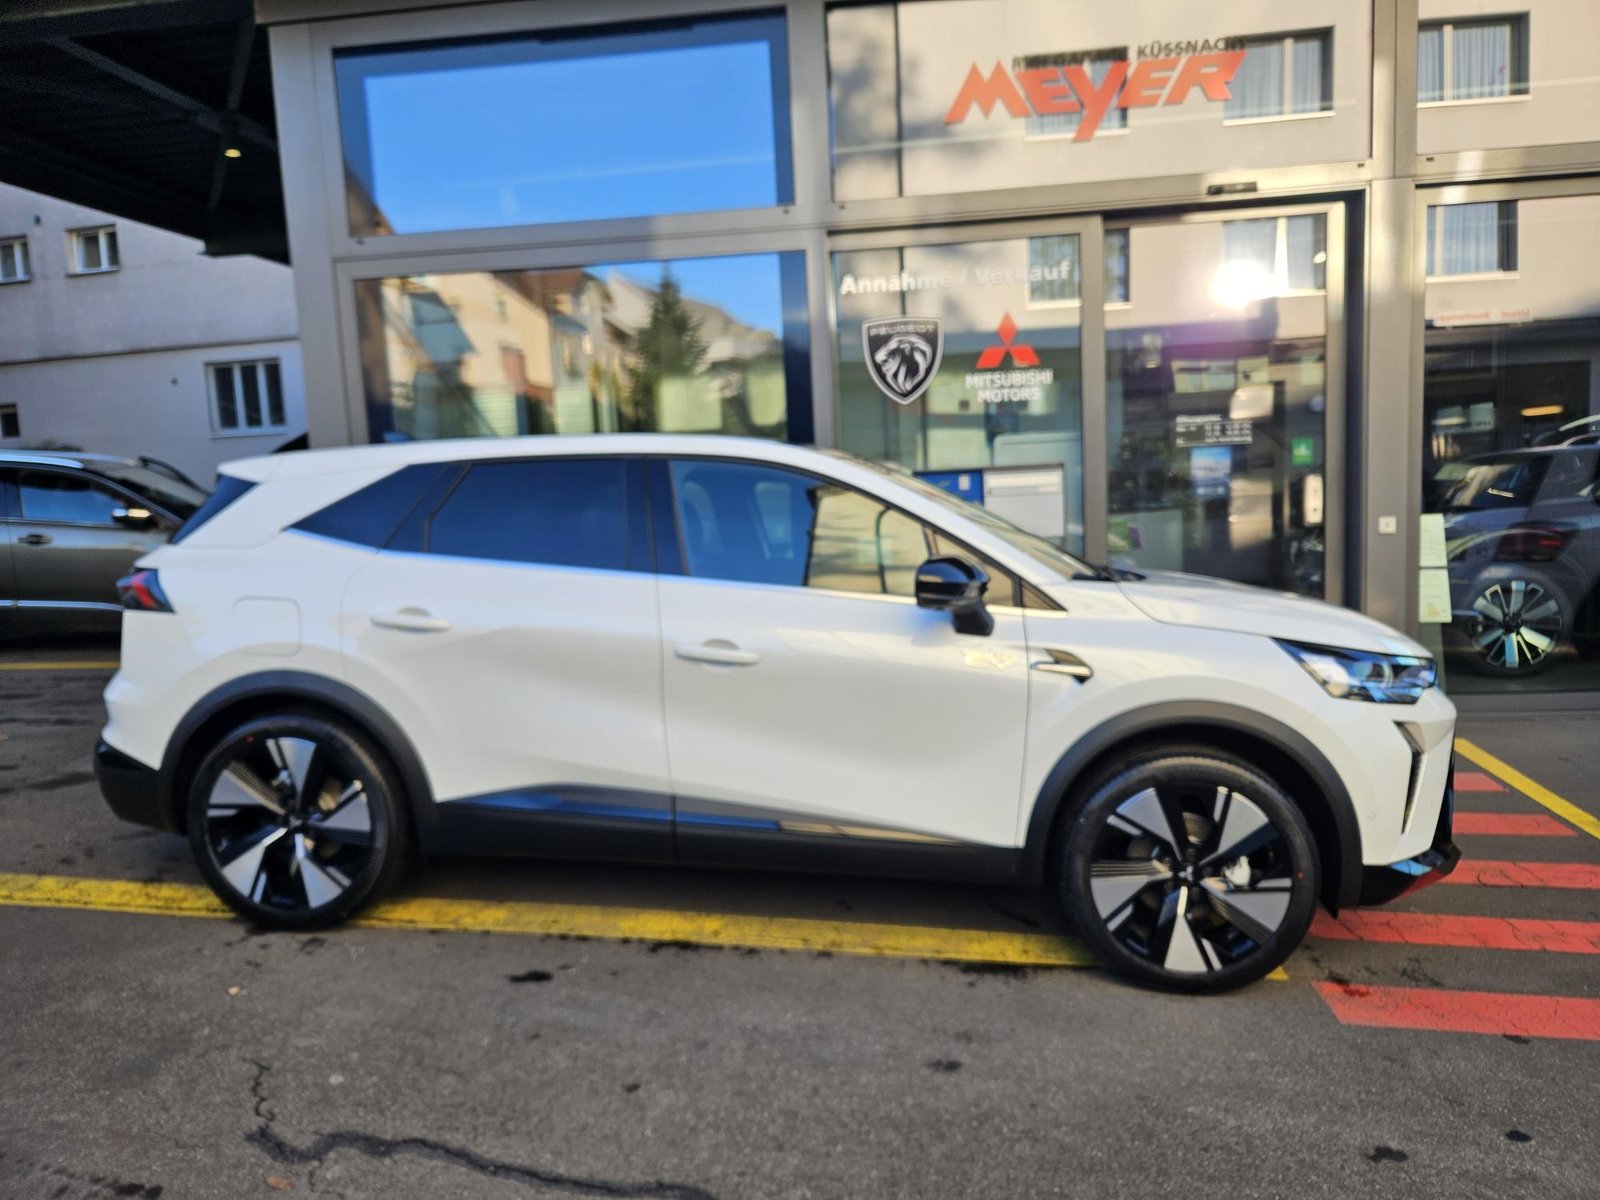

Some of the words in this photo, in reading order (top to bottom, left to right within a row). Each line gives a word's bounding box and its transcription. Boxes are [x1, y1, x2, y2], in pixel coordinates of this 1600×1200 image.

[944, 50, 1247, 142] MEYER
[840, 273, 952, 295] Annahme
[974, 261, 1072, 287] Verkauf
[869, 324, 936, 336] PEUGEOT
[964, 370, 1054, 388] MITSUBISHI
[977, 387, 1041, 403] MOTORS
